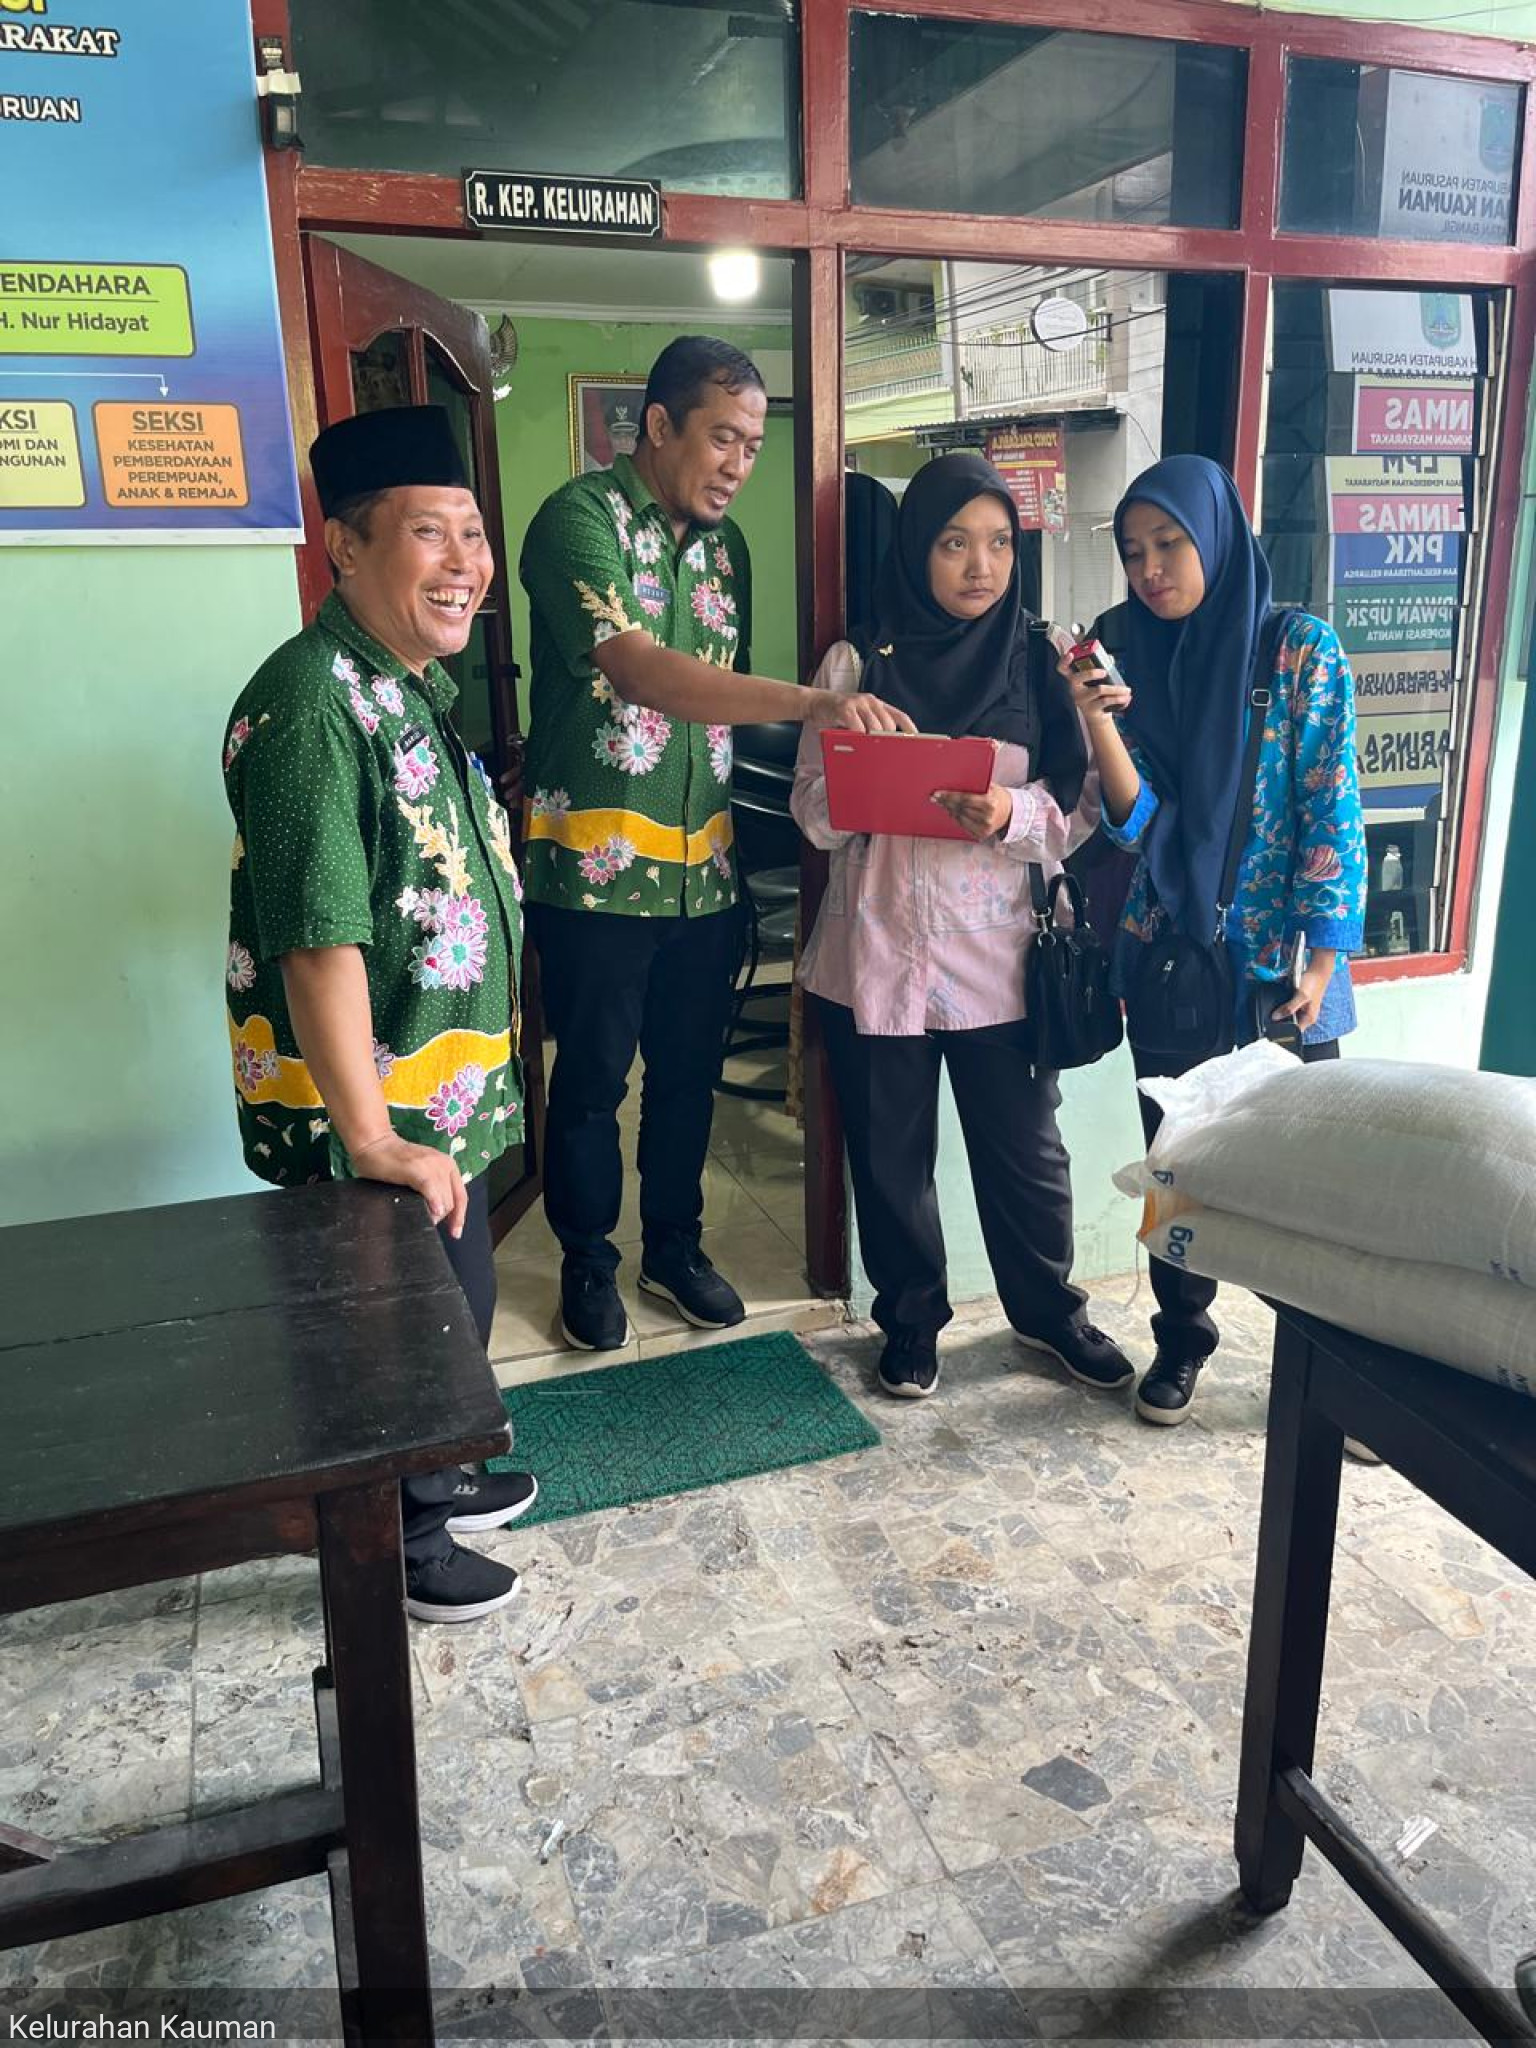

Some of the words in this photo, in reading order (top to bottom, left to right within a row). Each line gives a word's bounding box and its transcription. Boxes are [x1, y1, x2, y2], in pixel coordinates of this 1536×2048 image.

[0, 23, 118, 56] RAKAT
[0, 95, 81, 121] RUAN
[474, 182, 494, 217] R.
[499, 183, 539, 219] KEP.
[543, 186, 654, 225] KELURAHAN
[22, 311, 60, 329] Nur
[67, 312, 150, 333] Hidayat
[131, 410, 204, 431] SEKSI
[0, 439, 20, 450] MI
[25, 438, 58, 450] DAN
[127, 439, 214, 452] KESEHATAN
[113, 455, 232, 468] PEMBERDAYAAN
[128, 471, 223, 485] PEREMPUAN,
[117, 487, 161, 498] ANAK
[164, 487, 174, 498] &
[178, 487, 238, 499] REMAJA
